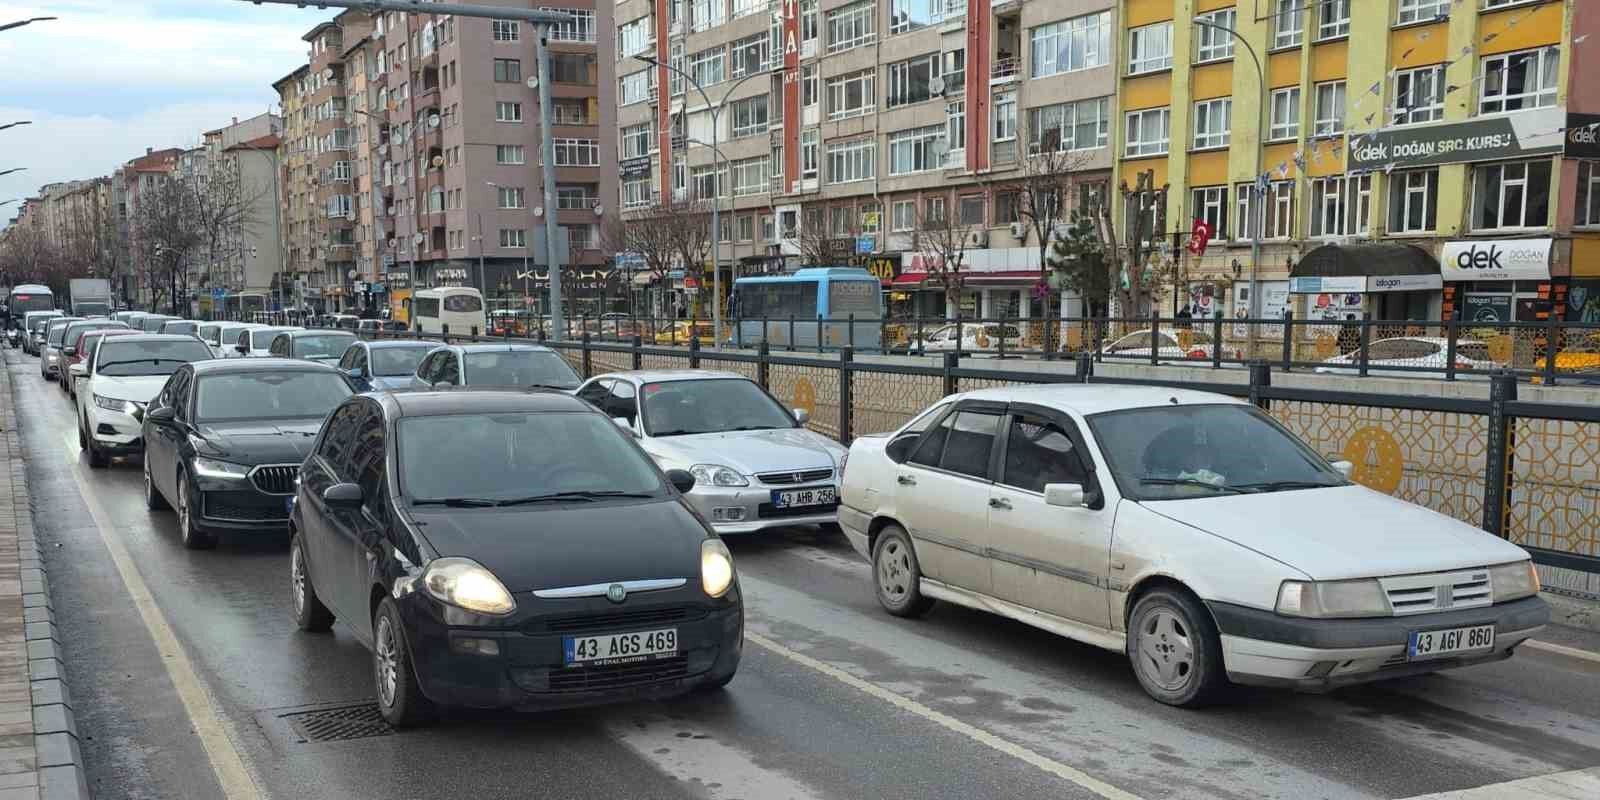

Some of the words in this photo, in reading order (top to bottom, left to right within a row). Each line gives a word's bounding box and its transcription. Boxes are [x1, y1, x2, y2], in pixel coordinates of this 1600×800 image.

[1361, 143, 1387, 160] dek
[1393, 141, 1434, 157] DOĞAN
[1438, 138, 1463, 153] SRC
[1466, 133, 1511, 150] KURSU
[1575, 127, 1597, 143] dek
[1457, 244, 1503, 269] dek
[781, 493, 792, 504] 43
[797, 491, 813, 504] AHB
[577, 639, 598, 658] 43
[609, 634, 641, 656] AGS
[645, 630, 675, 651] 469
[1417, 634, 1432, 653] 43
[1468, 628, 1491, 647] 860
